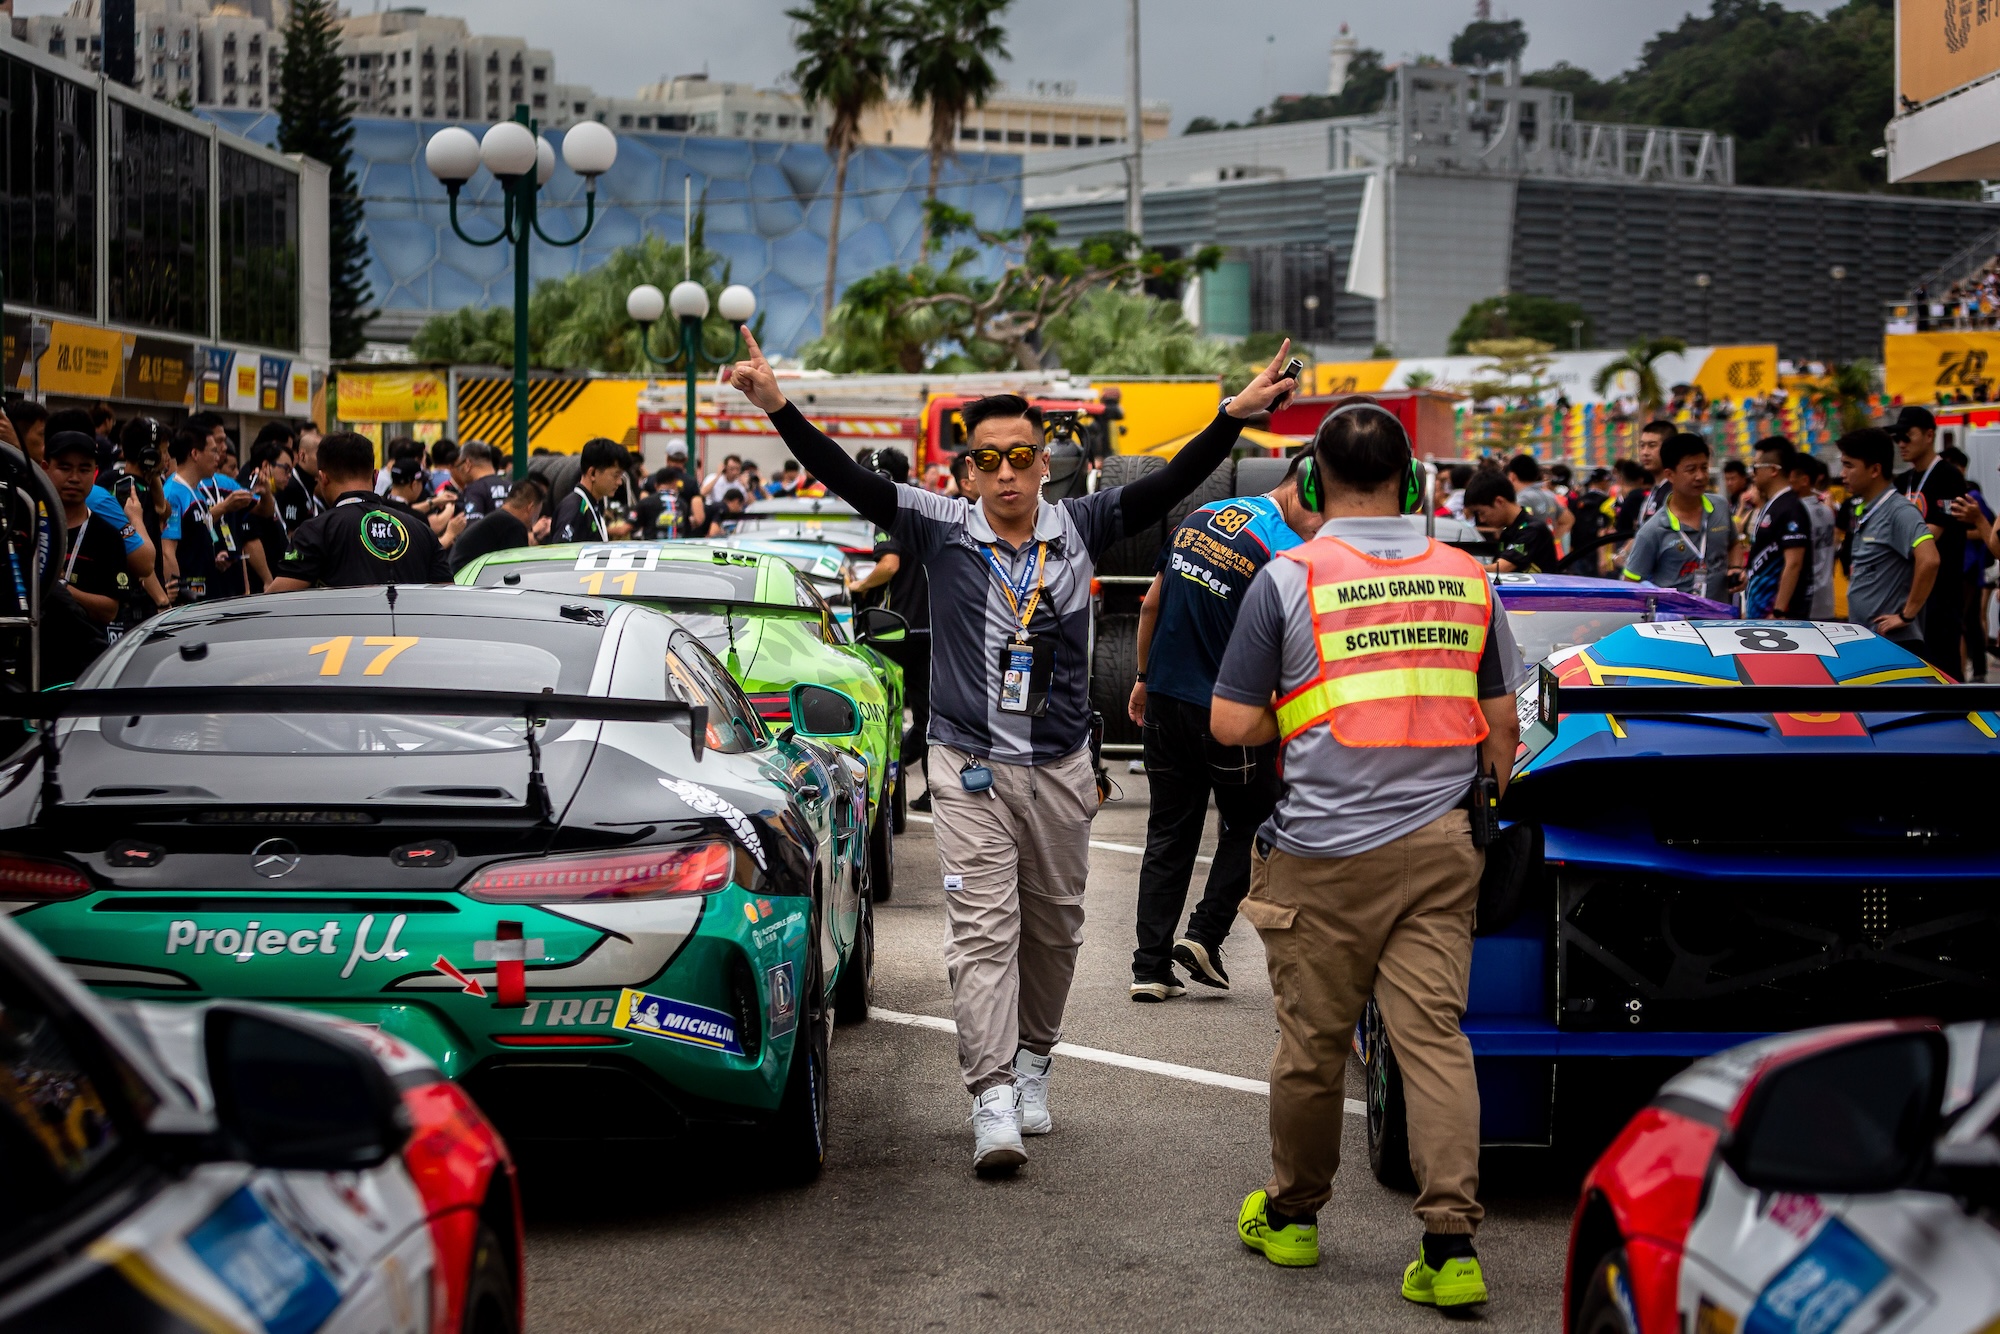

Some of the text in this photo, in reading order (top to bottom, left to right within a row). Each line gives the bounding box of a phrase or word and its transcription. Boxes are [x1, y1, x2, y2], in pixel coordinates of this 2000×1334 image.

[1215, 509, 1248, 533] 88
[583, 549, 649, 569] 11
[579, 571, 639, 596] 11
[1171, 552, 1232, 595] Border
[1337, 580, 1466, 604] MACAU GRAND PRIX
[1345, 627, 1469, 652] SCRUTINEERING
[1734, 628, 1799, 652] 8
[308, 635, 420, 676] 17
[165, 919, 342, 963] Project
[519, 997, 615, 1027] TRC
[662, 1012, 735, 1043] MICHELIN
